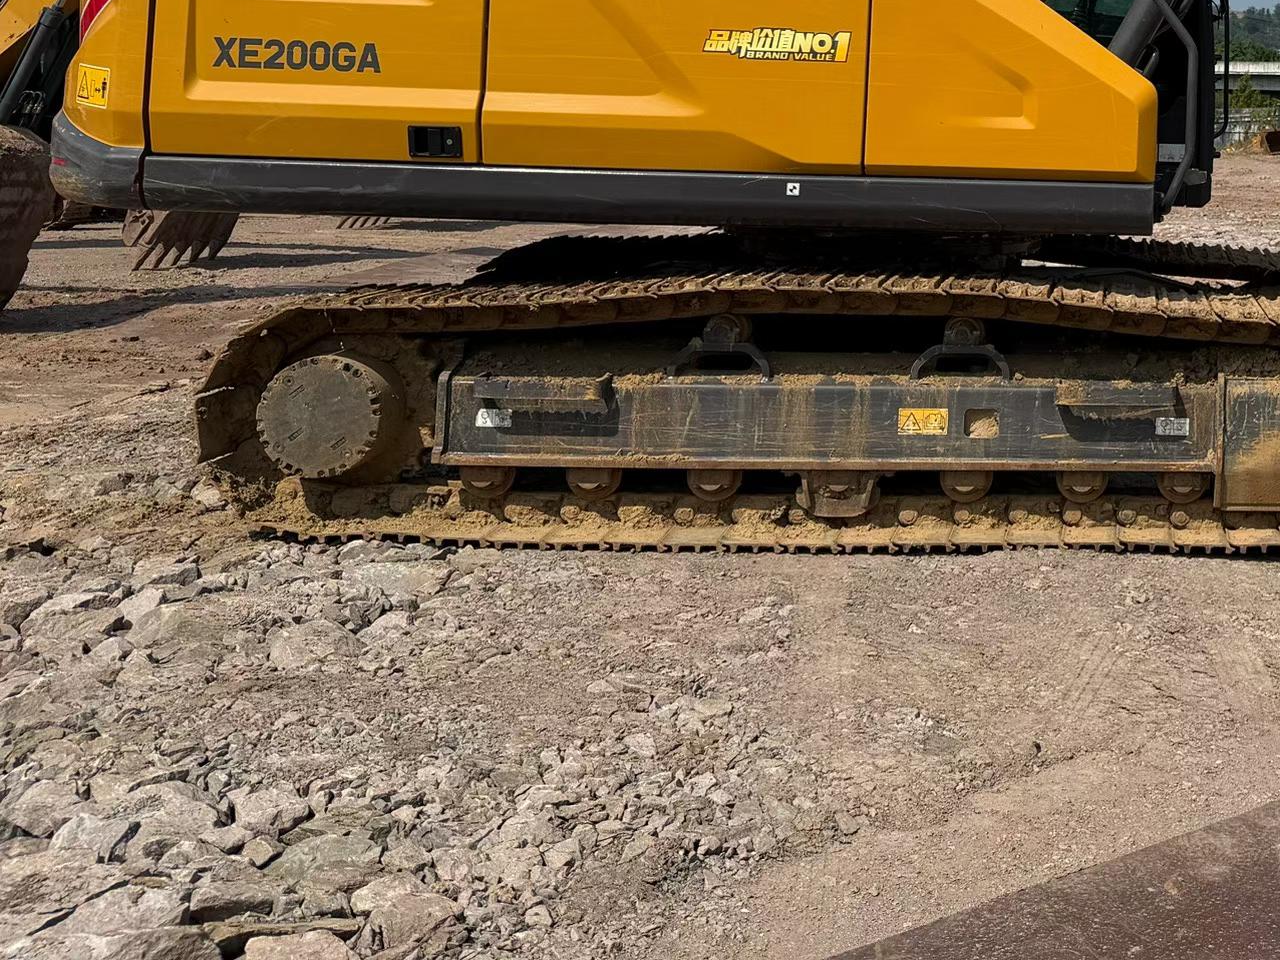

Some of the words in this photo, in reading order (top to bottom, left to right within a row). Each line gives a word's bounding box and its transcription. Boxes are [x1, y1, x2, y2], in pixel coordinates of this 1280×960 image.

[212, 36, 382, 73] XE200GA
[746, 51, 789, 60] BRAND
[793, 52, 833, 61] VALUE
